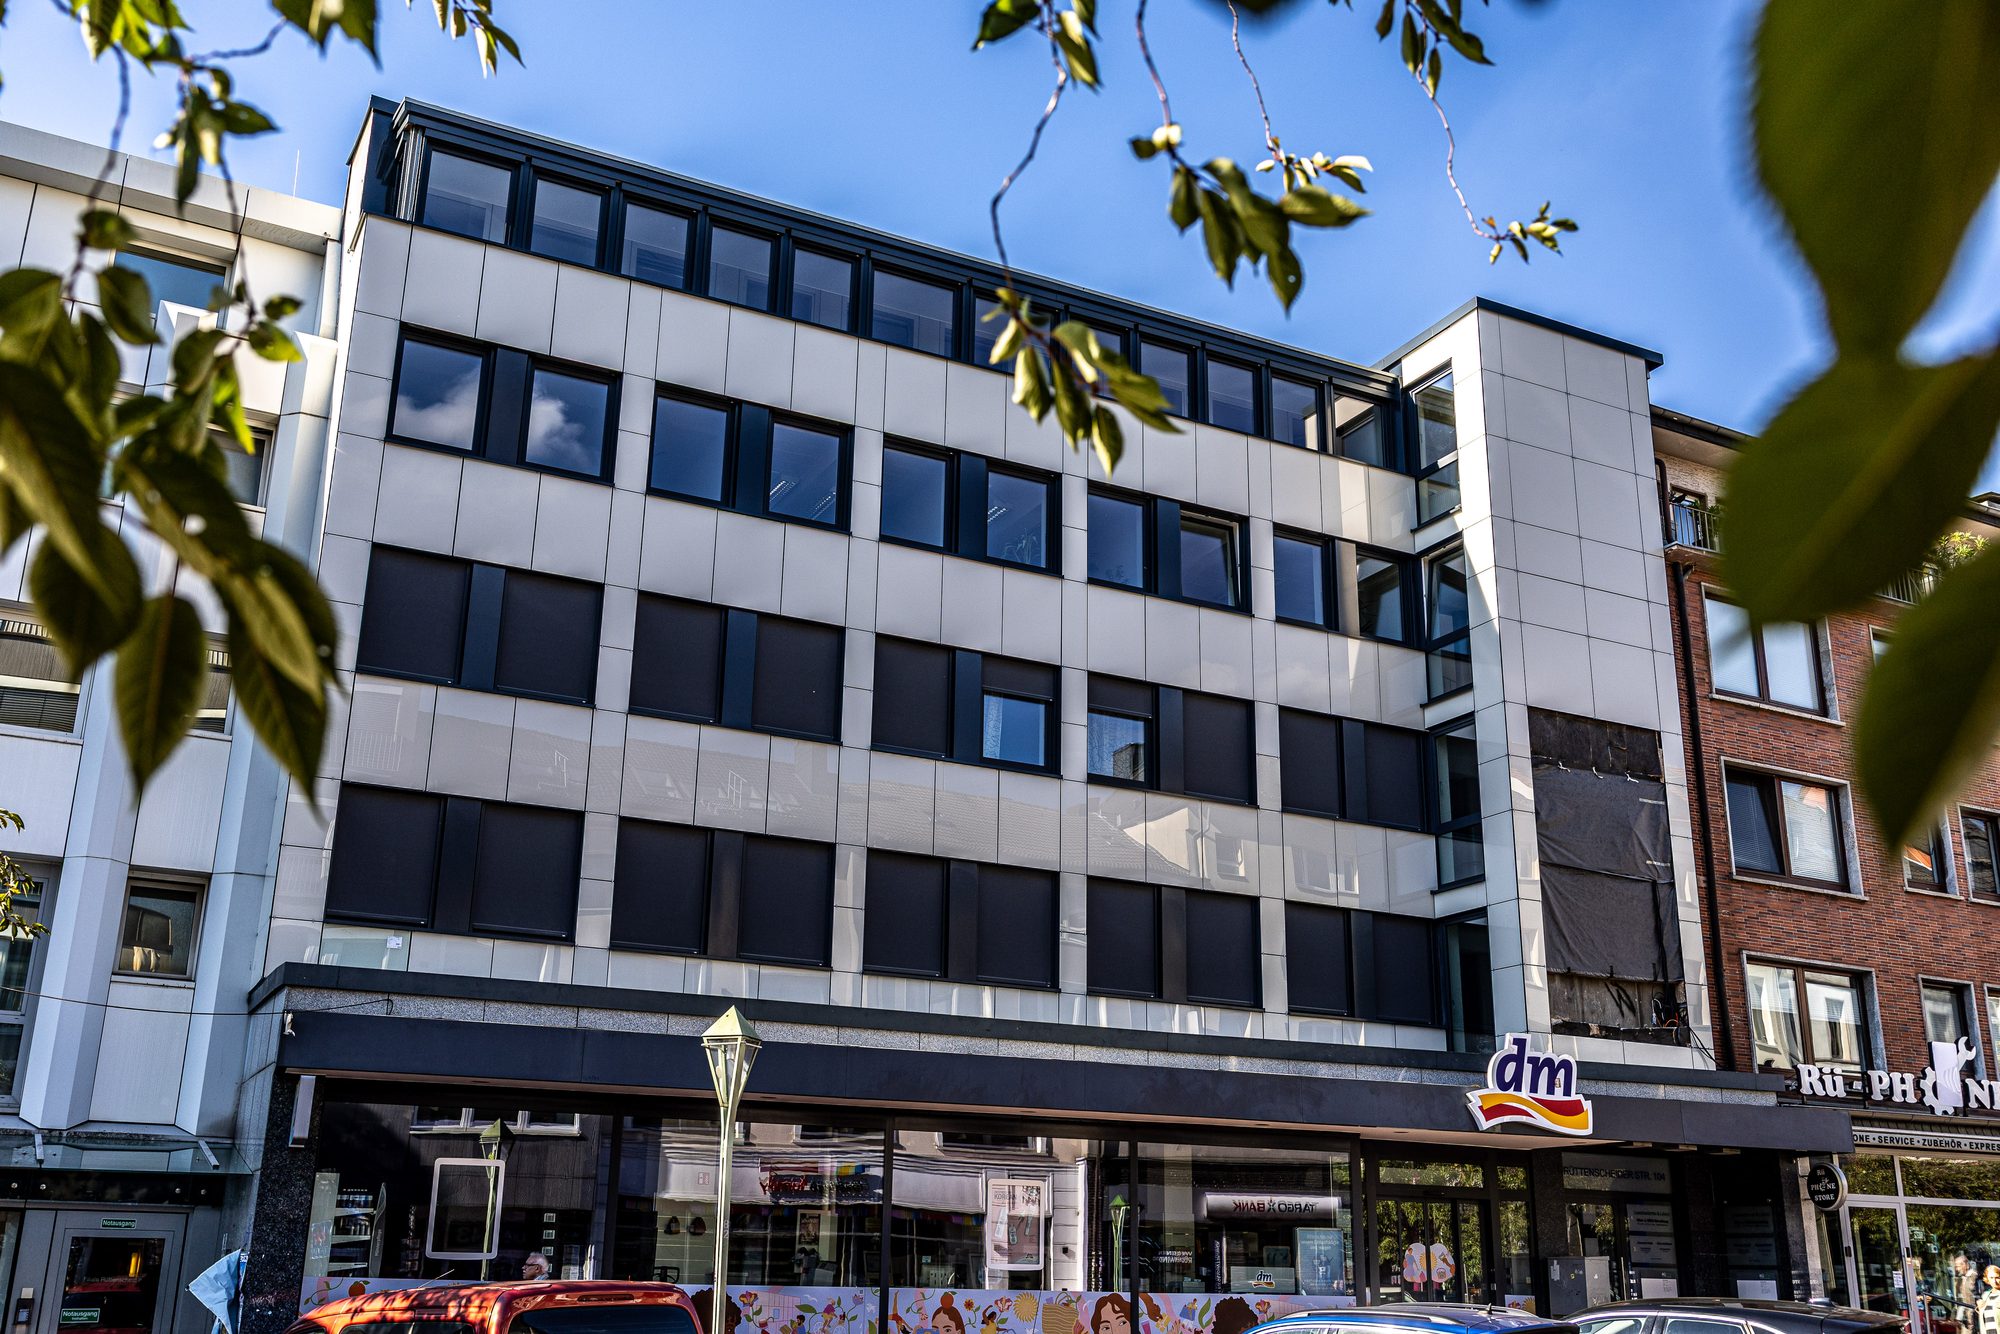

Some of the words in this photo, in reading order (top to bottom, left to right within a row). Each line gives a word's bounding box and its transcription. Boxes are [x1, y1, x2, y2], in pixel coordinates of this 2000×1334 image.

[1496, 1038, 1573, 1097] dm
[1853, 1134, 1870, 1142] ONE
[1878, 1136, 1915, 1146] SERVICE
[1921, 1138, 1962, 1149] ZUBEHÖR
[1814, 1193, 1835, 1201] STORE
[102, 1220, 135, 1228] Notausgang
[1256, 1270, 1272, 1282] dm
